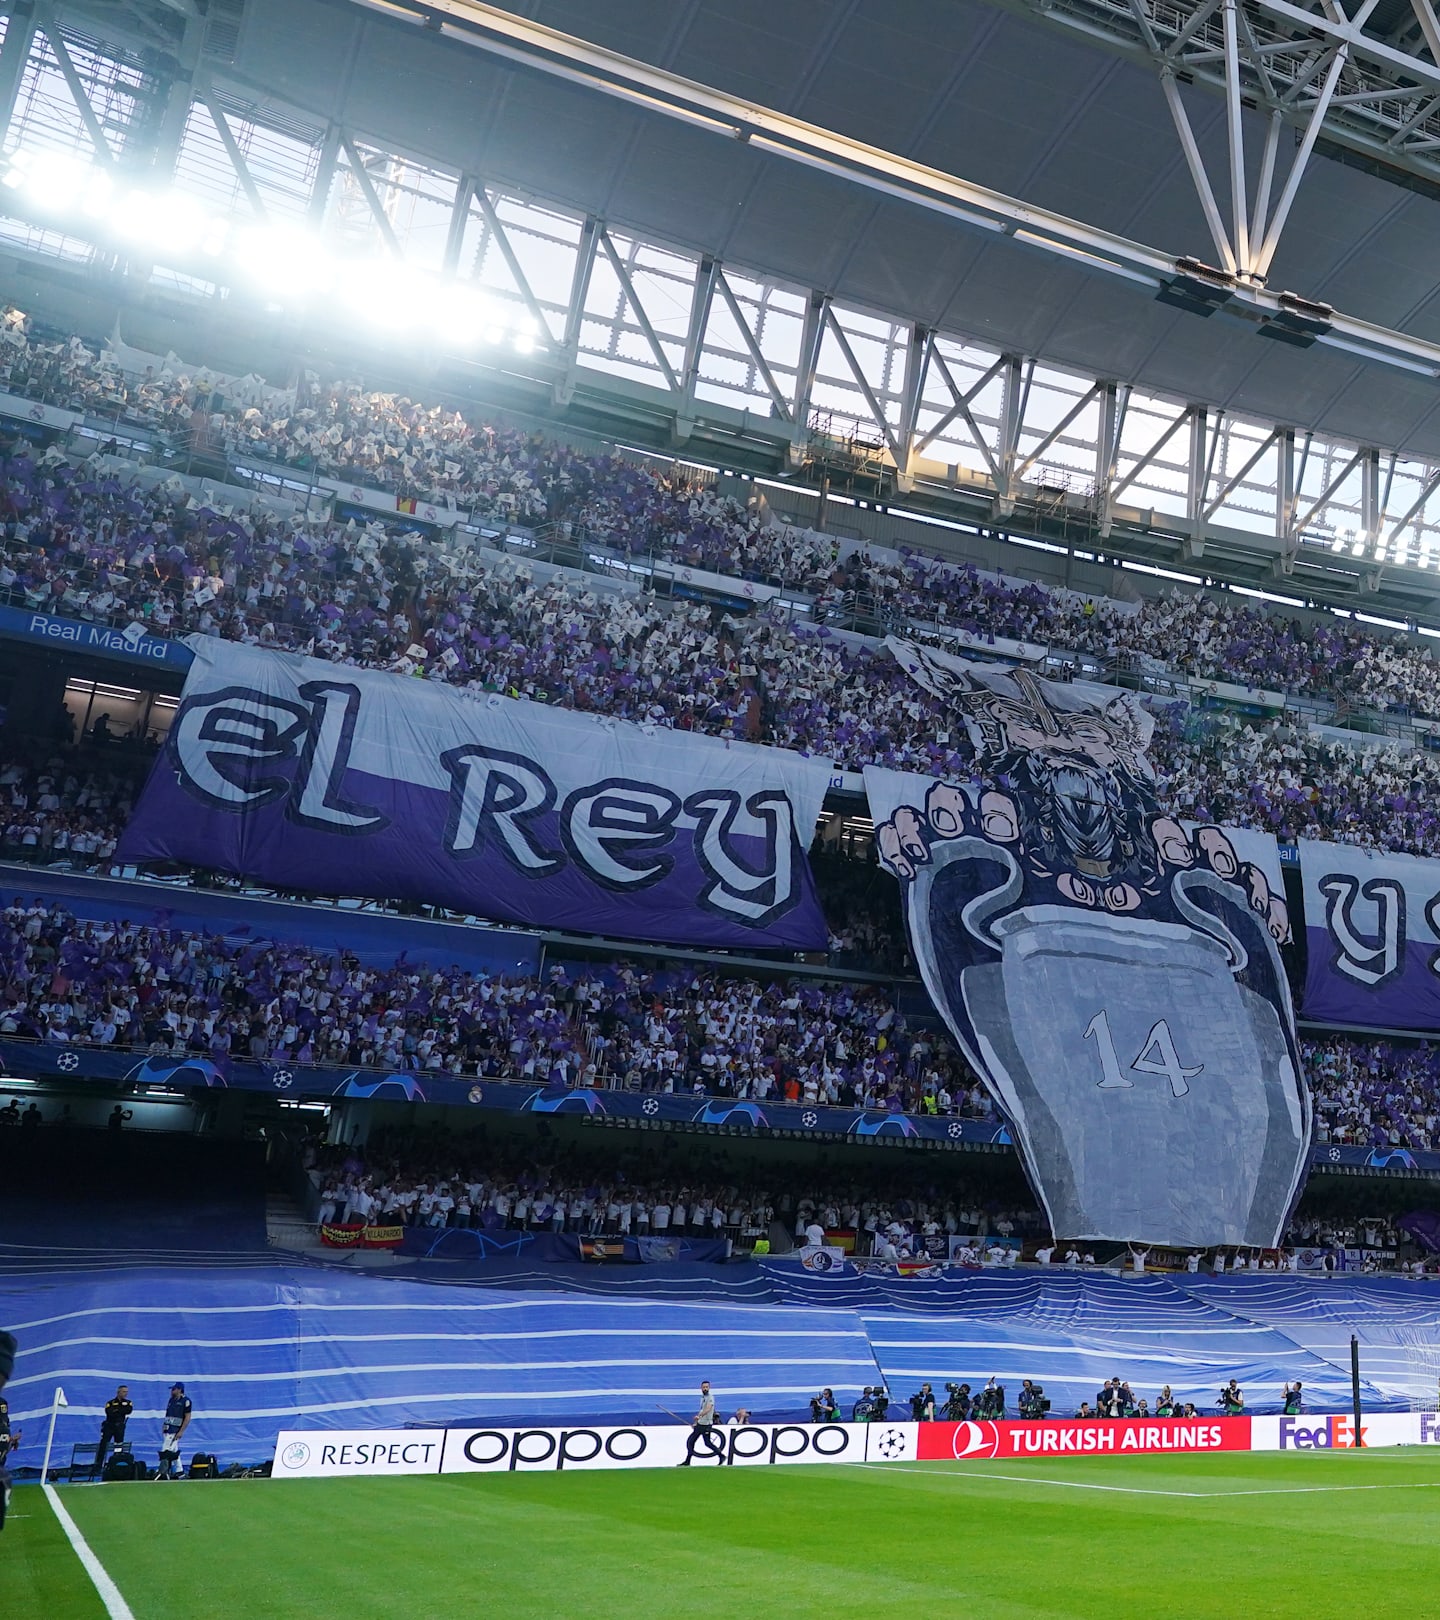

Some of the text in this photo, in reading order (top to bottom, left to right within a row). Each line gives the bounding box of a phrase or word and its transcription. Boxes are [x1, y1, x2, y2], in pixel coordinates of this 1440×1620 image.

[30, 615, 82, 641] Real
[1083, 1009, 1204, 1097] 14
[1010, 1425, 1222, 1451] TURKISH AIRLINES
[1280, 1416, 1367, 1449] FedEx
[320, 1443, 436, 1466] RESPECT
[464, 1428, 648, 1470] oppo
